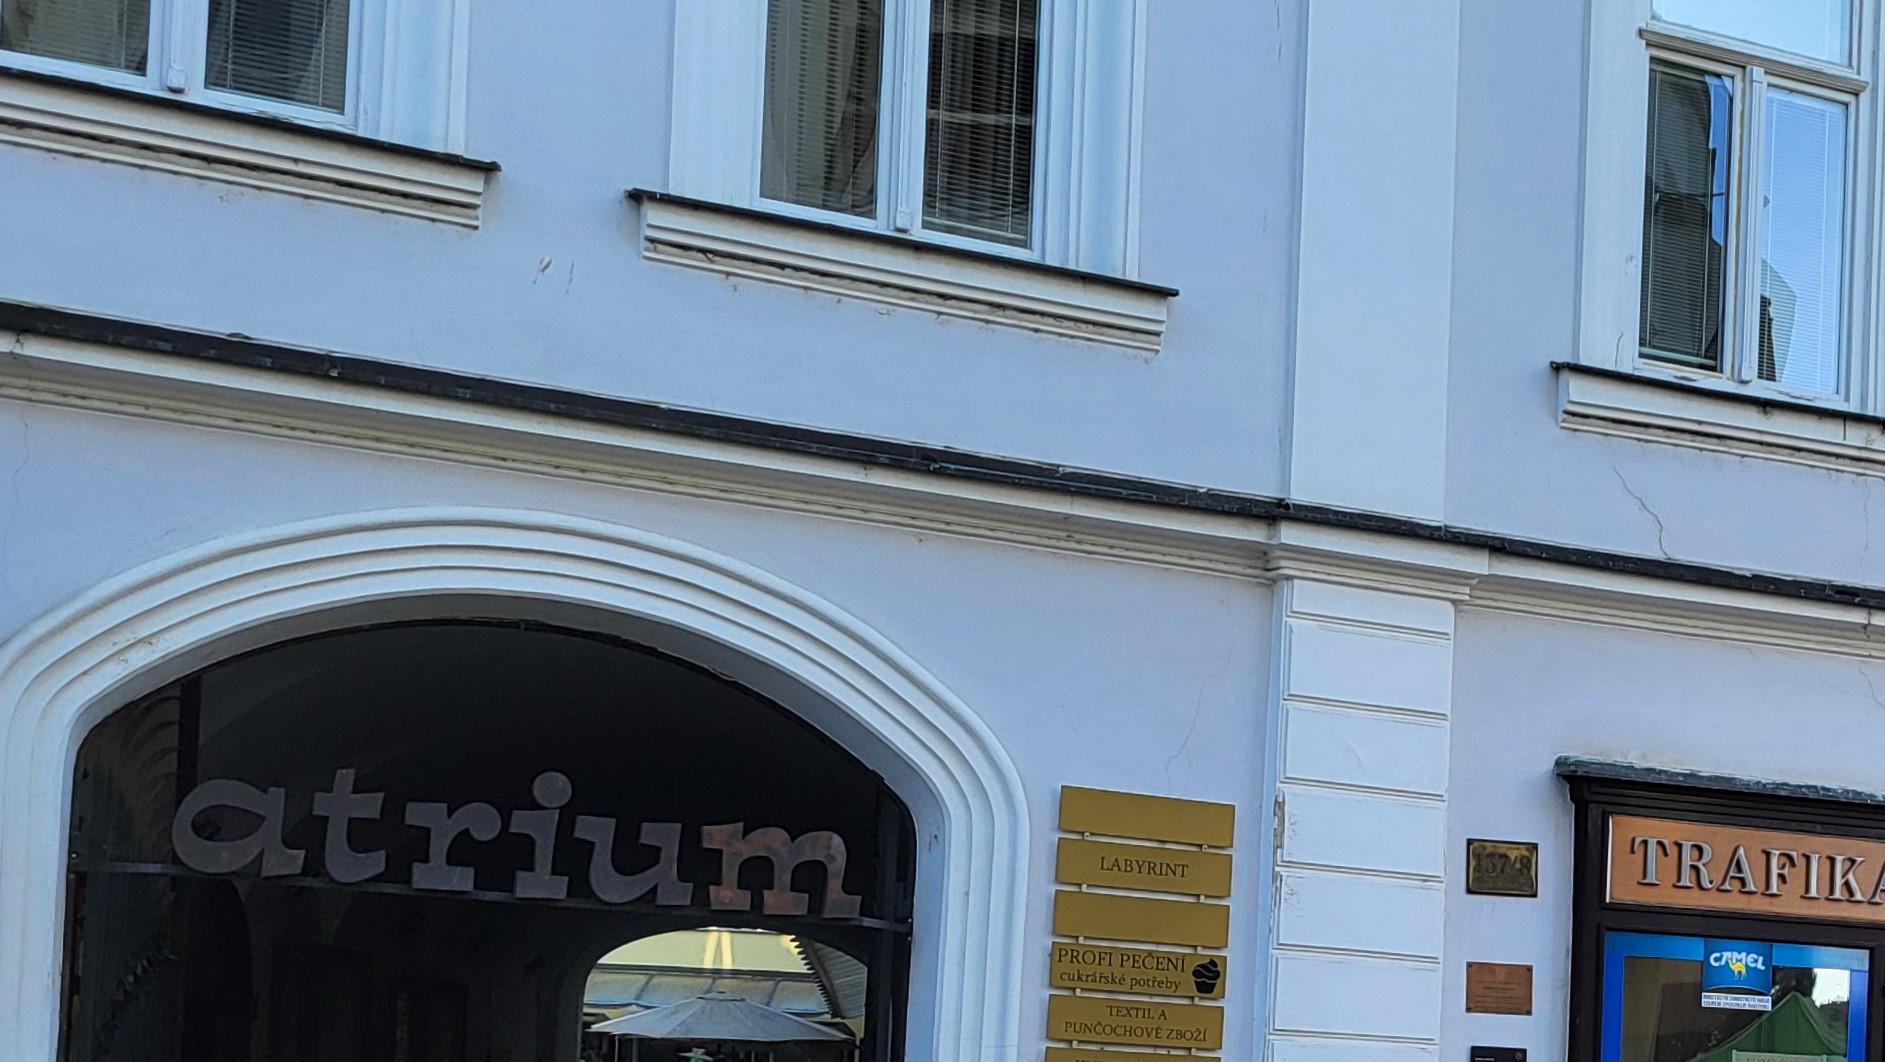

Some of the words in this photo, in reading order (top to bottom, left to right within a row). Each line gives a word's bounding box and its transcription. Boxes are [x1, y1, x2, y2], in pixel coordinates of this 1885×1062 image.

[171, 768, 862, 918] atrium
[1100, 856, 1189, 878] LABYRINT
[1057, 947, 1113, 968] PROFI
[1119, 952, 1187, 973] PEČENÍ
[1709, 951, 1766, 970] CAMEL
[1060, 970, 1126, 987] cukrářské
[1129, 975, 1182, 993] potřeby
[1106, 1005, 1154, 1020] TEXTIL
[1157, 1010, 1167, 1021] A
[1064, 1021, 1163, 1040] PUNČOCHOVÉ
[1166, 1027, 1207, 1042] ZBOŽÍ
